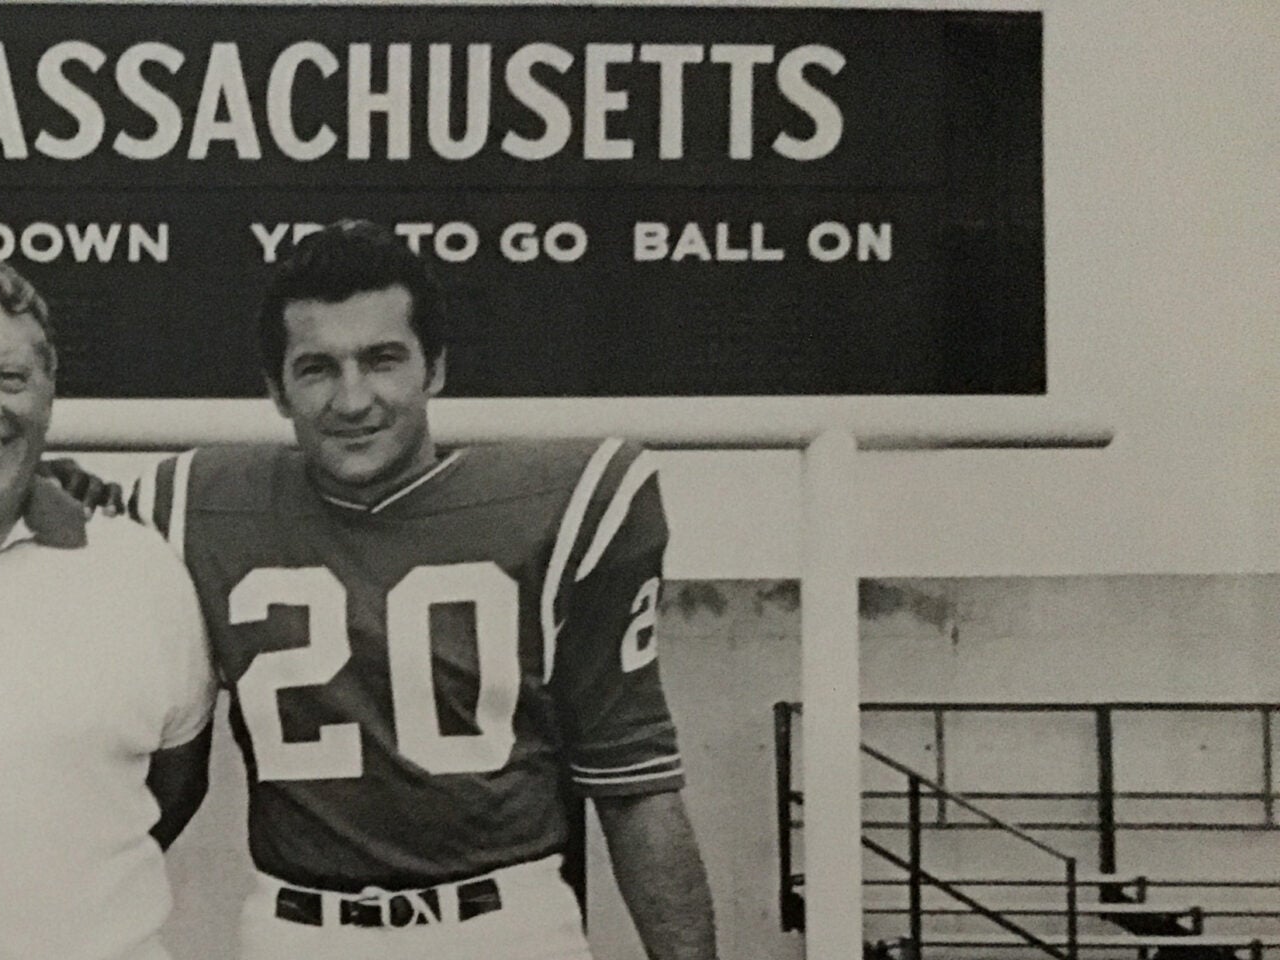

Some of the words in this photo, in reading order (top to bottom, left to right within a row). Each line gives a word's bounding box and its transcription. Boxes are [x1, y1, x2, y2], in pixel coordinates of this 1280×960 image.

[395, 221, 479, 262] TO
[500, 221, 588, 262] GO
[634, 222, 785, 262] BALL
[808, 221, 892, 262] ON
[227, 561, 522, 783] 20
